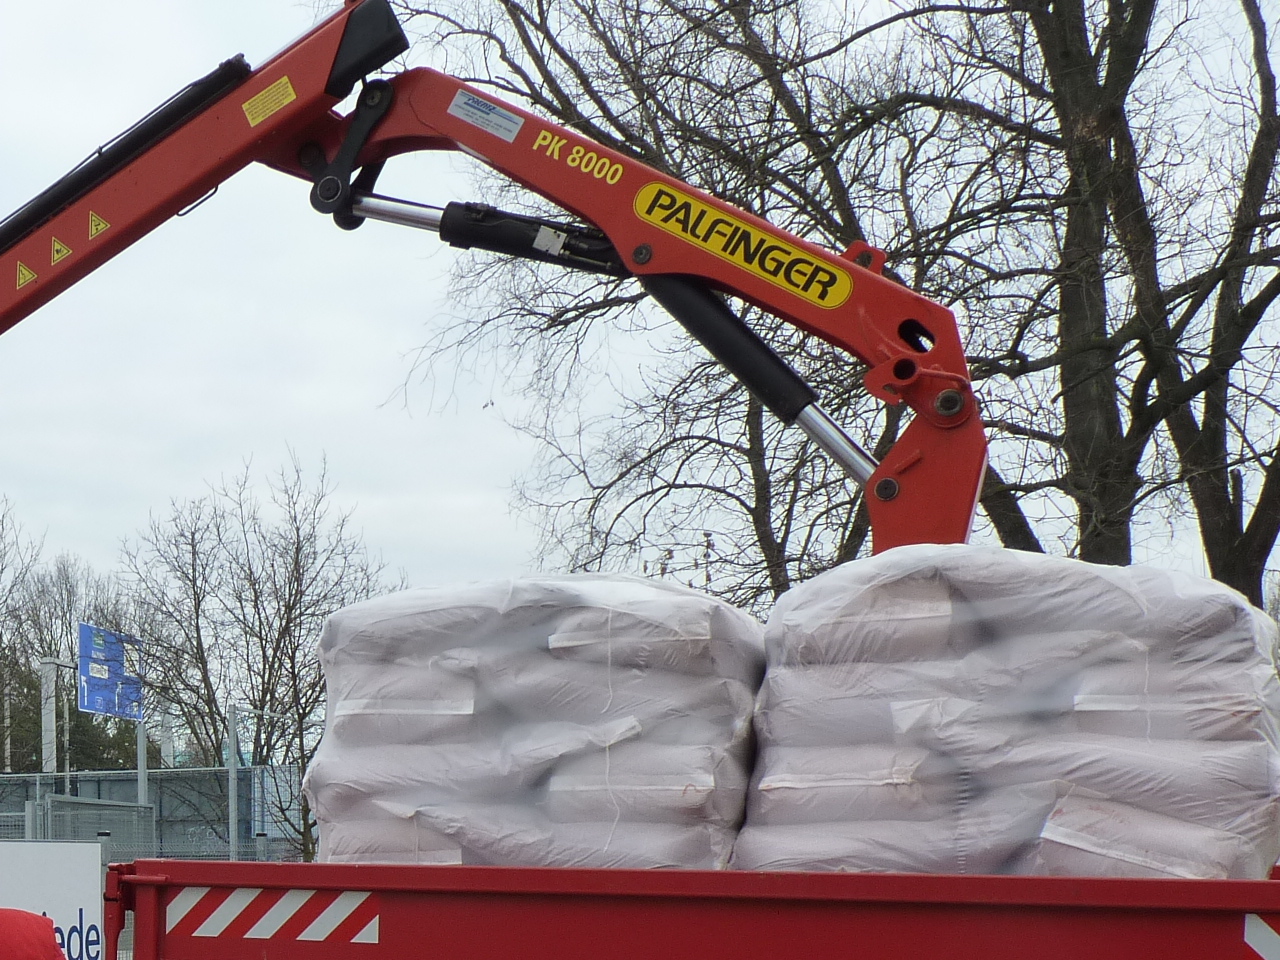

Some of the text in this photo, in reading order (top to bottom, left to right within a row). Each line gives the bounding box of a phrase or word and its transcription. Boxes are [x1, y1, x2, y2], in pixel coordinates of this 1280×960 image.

[532, 130, 624, 185] PK 8000
[645, 188, 838, 302] PALFINGER
